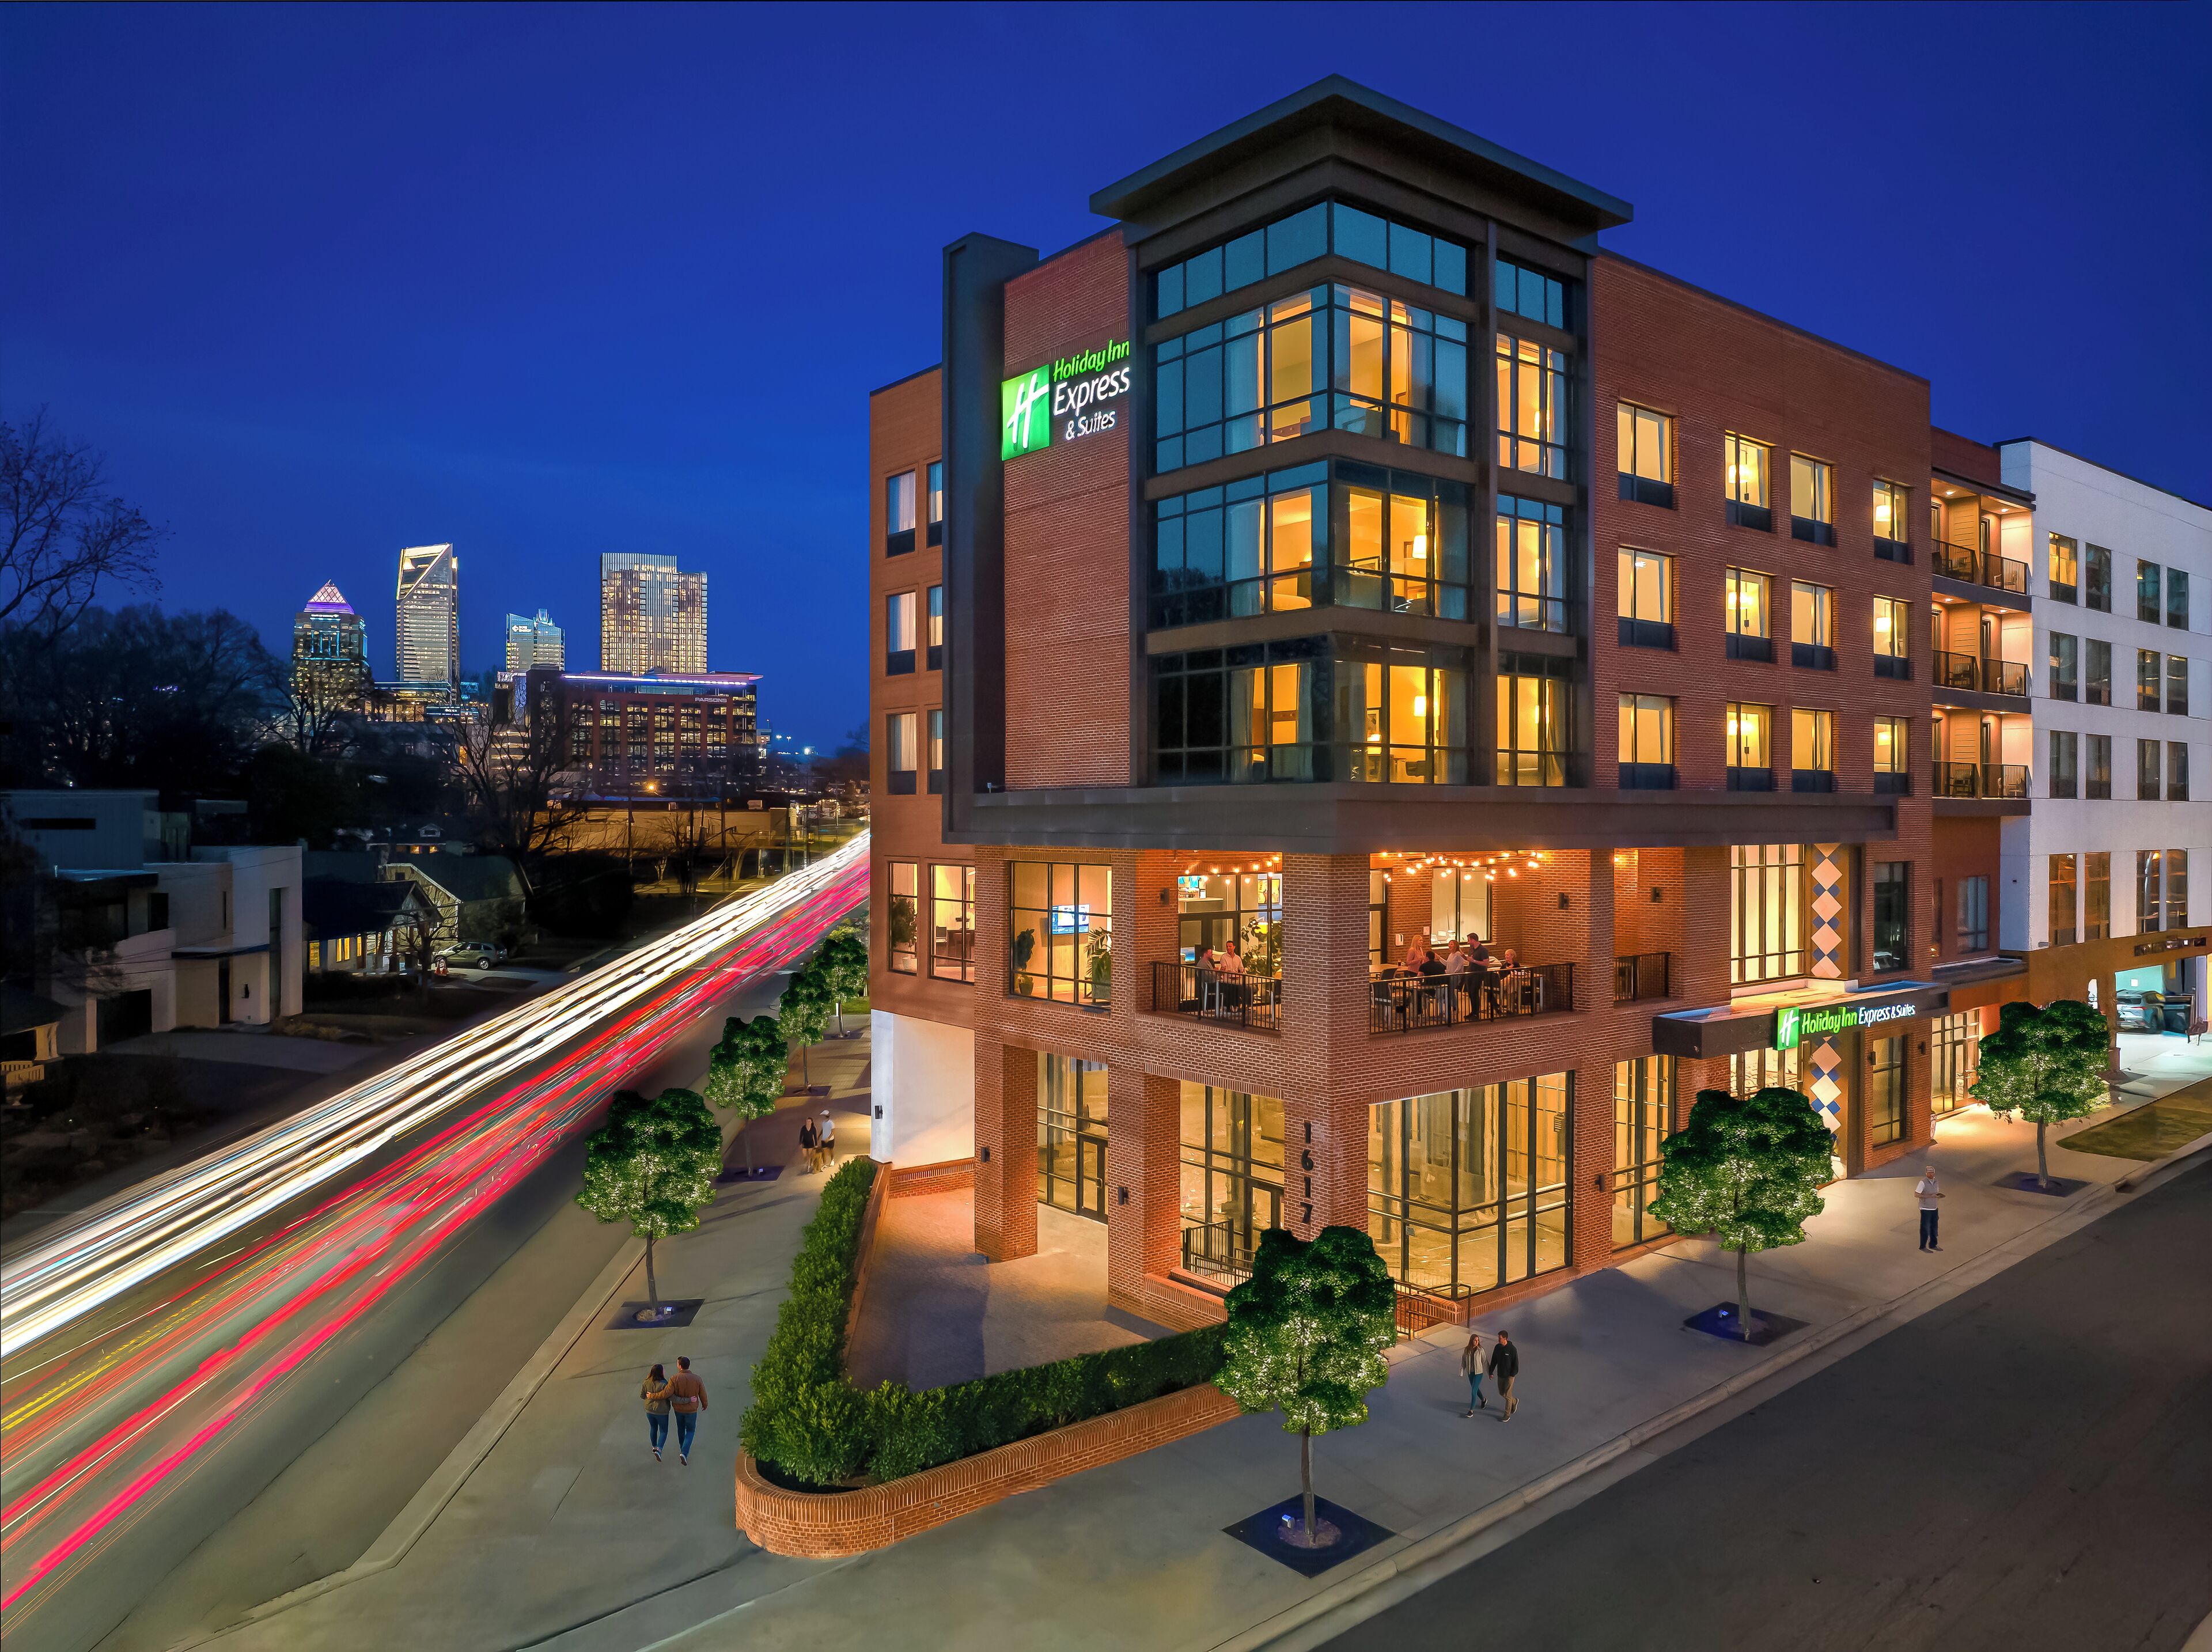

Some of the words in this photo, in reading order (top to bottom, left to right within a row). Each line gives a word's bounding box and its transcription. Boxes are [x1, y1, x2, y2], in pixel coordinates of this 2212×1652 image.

[1054, 349, 1105, 382] Holiday
[1107, 339, 1130, 362] Inn
[1054, 367, 1130, 416] Express
[1065, 420, 1076, 441] &
[1077, 410, 1116, 437] Suites
[1802, 1010, 1840, 1035] Holiday
[1841, 1006, 1858, 1027] Inn
[1858, 1006, 1891, 1028] Express
[1890, 1007, 1896, 1019] &
[1896, 1003, 1916, 1018] Suites
[1300, 1120, 1314, 1224] 1617
